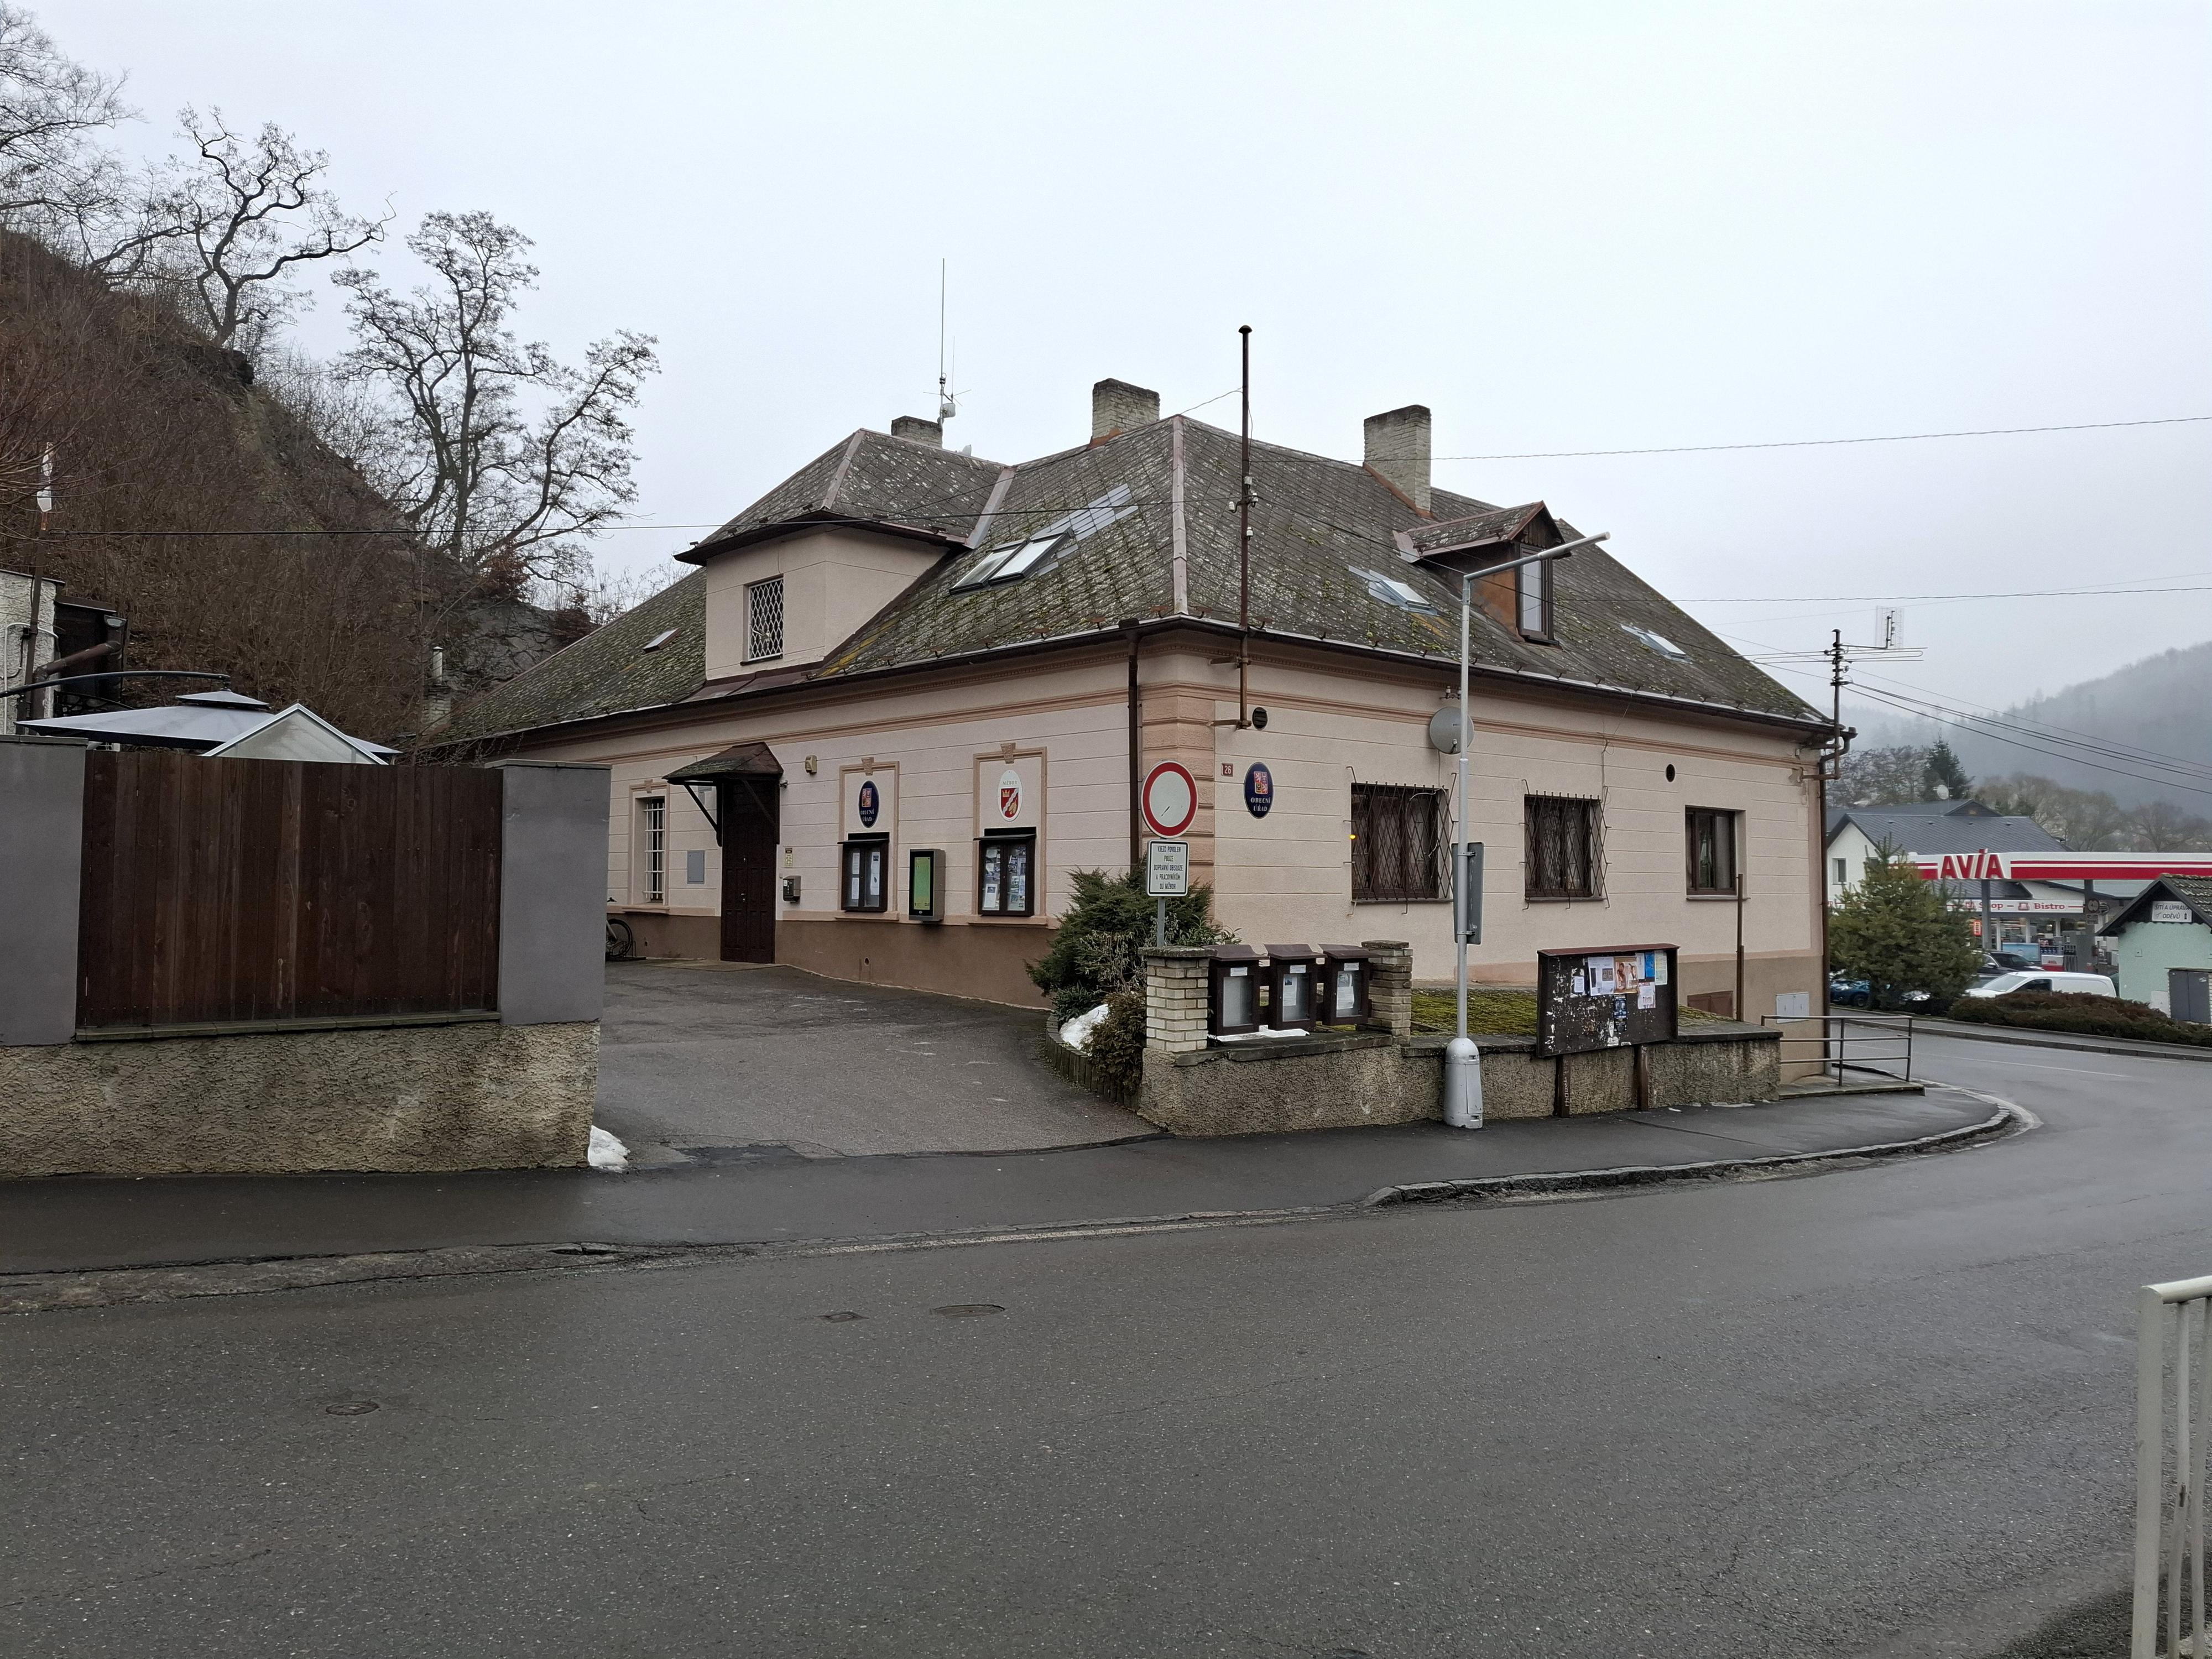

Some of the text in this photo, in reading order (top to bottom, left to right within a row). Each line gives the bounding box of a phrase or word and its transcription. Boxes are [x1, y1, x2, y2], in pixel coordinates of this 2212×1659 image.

[1224, 765, 1232, 774] 26
[1940, 849, 2005, 879] AVIA
[1979, 902, 2004, 910] Sop
